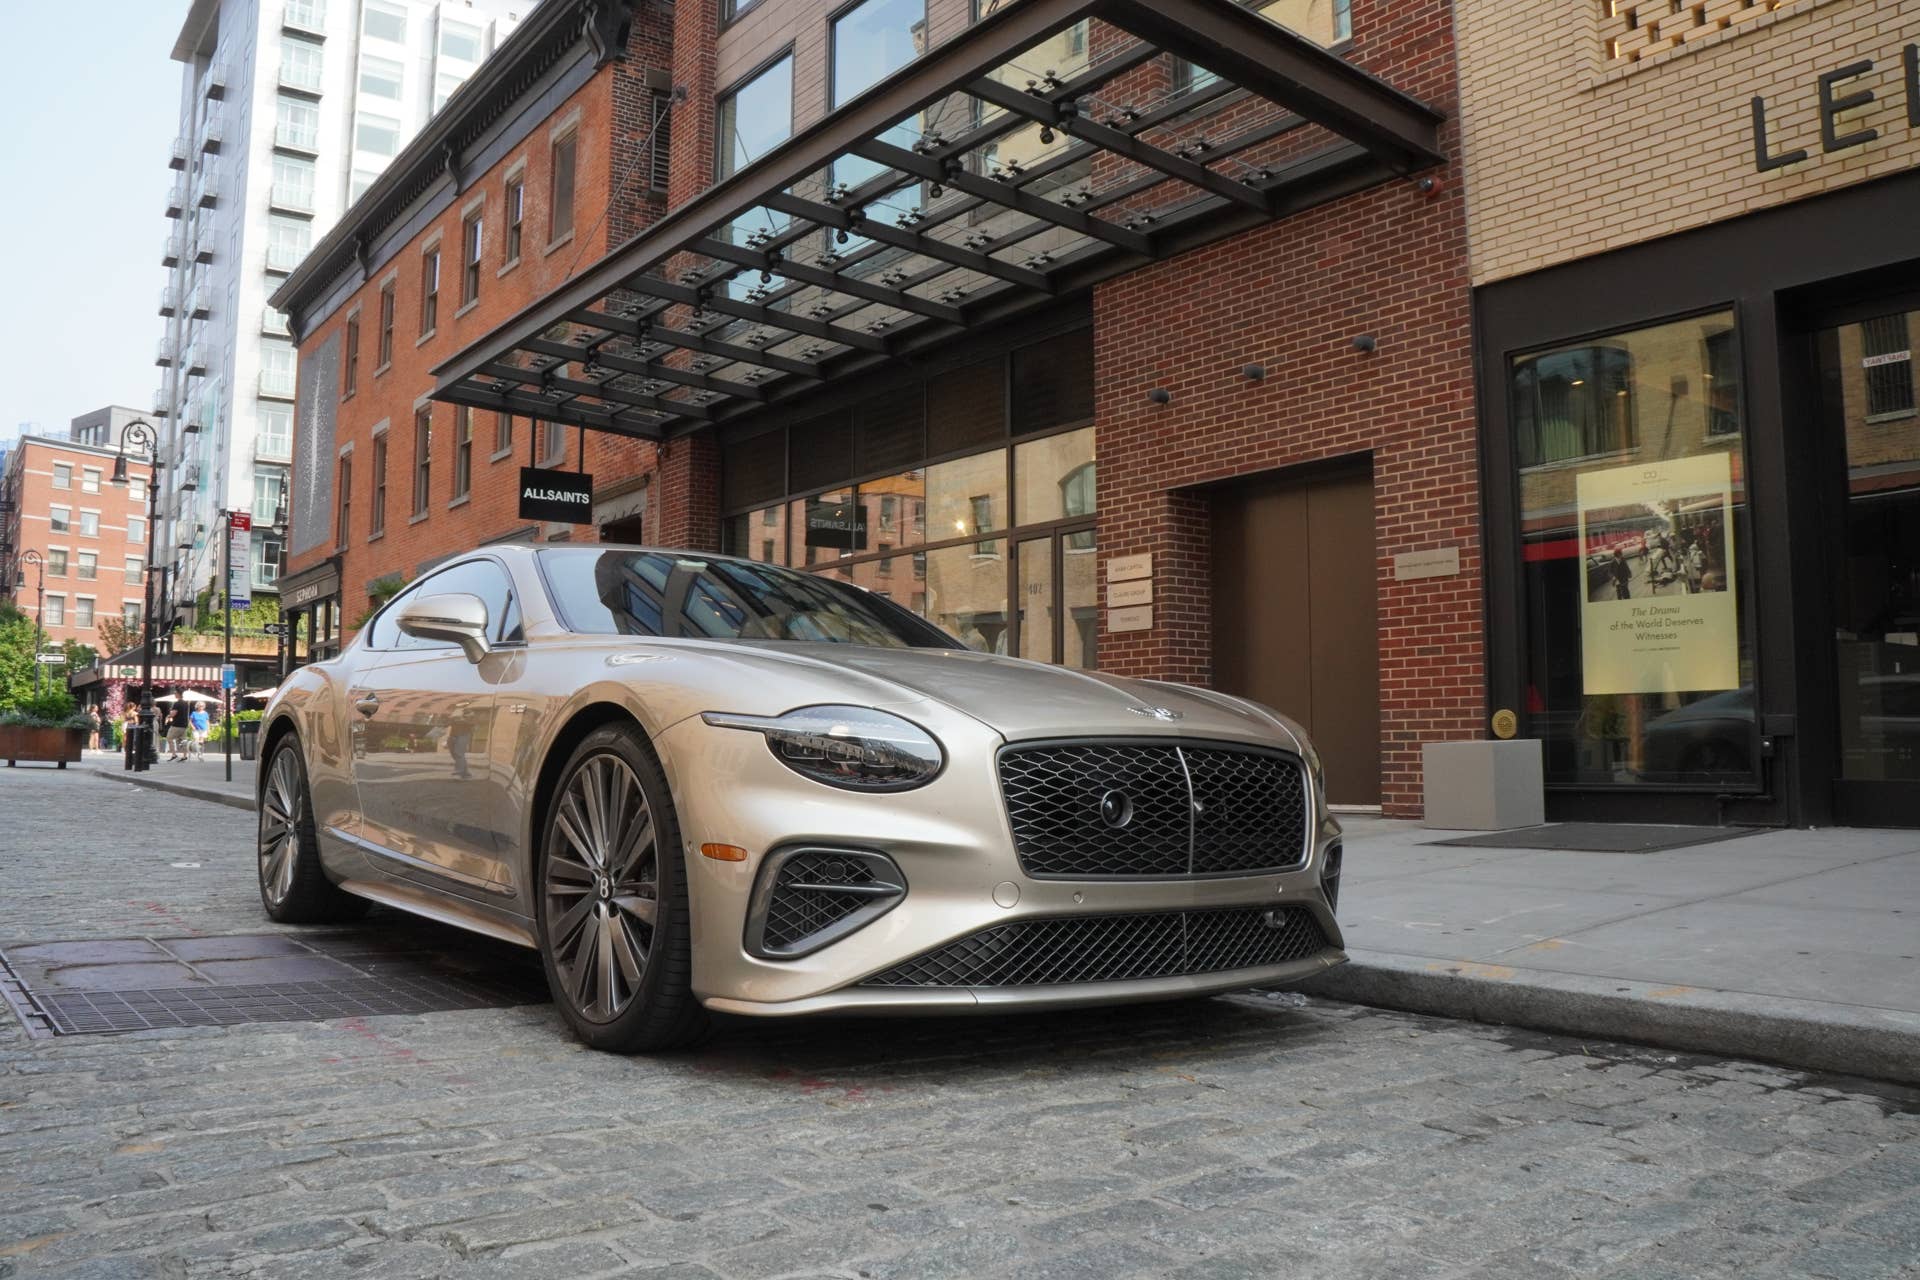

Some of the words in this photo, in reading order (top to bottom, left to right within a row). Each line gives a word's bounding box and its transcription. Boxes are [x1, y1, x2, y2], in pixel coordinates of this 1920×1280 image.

[523, 487, 590, 504] ALLSAINTS
[1631, 607, 1647, 616] The
[1650, 606, 1680, 615] Drama
[1610, 622, 1619, 631] of
[1620, 621, 1634, 630] the
[1636, 619, 1663, 629] World
[1665, 617, 1704, 627] Deserves
[1635, 632, 1678, 641] Witnesses
